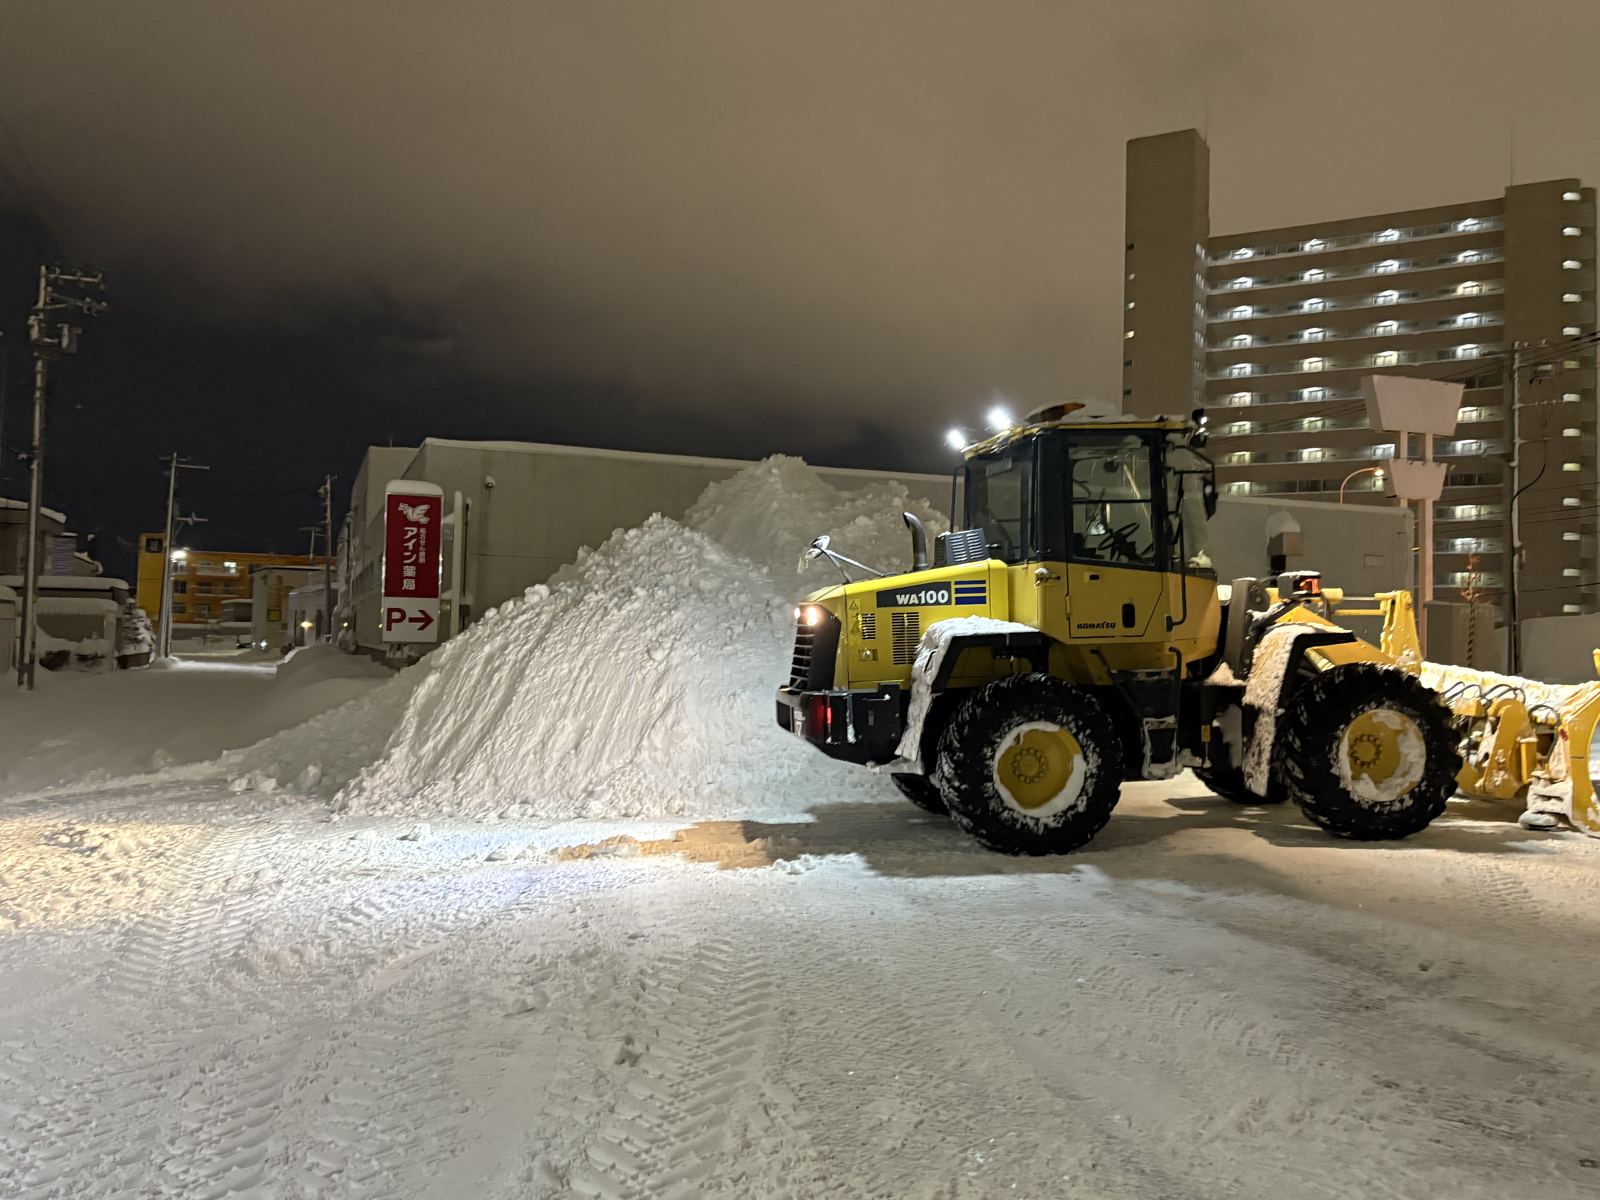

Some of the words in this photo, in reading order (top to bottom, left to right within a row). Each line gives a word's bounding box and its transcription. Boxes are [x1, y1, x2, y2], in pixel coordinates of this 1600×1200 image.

[402, 526, 418, 591] アイン薬局
[895, 589, 949, 605] WA100
[386, 607, 407, 632] P
[1077, 621, 1116, 629] KOMATSU
